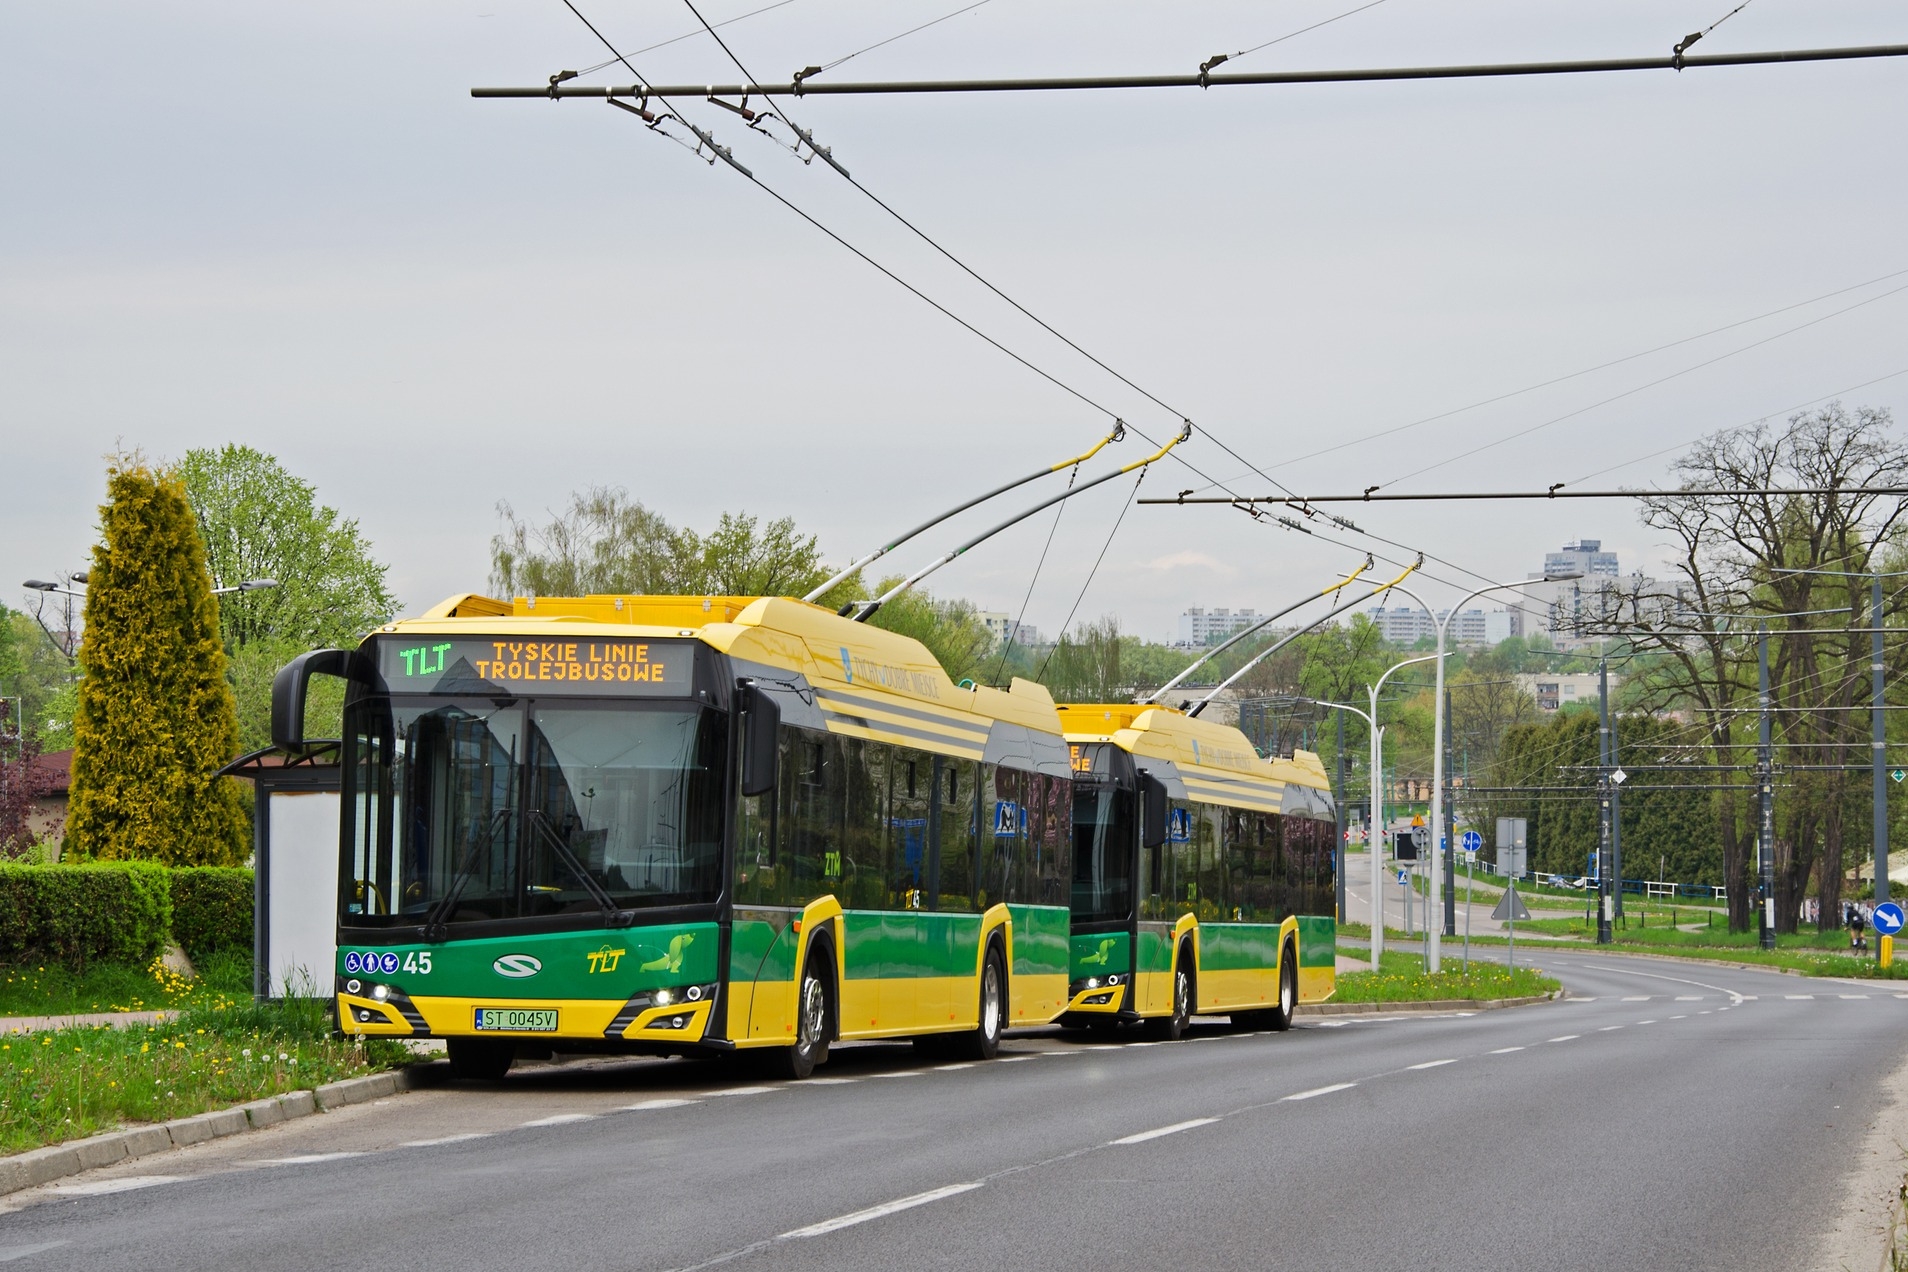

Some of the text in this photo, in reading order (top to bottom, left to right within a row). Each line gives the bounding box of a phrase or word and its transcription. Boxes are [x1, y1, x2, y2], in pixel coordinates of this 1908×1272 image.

[400, 643, 451, 676] TLT
[493, 642, 649, 663] TYSKIE LINIE
[476, 661, 664, 682] TROLEJBUSOWE
[825, 850, 840, 877] ZTM
[402, 952, 432, 975] 45
[587, 948, 626, 974] TLT
[485, 1011, 553, 1026] ST 0045V
